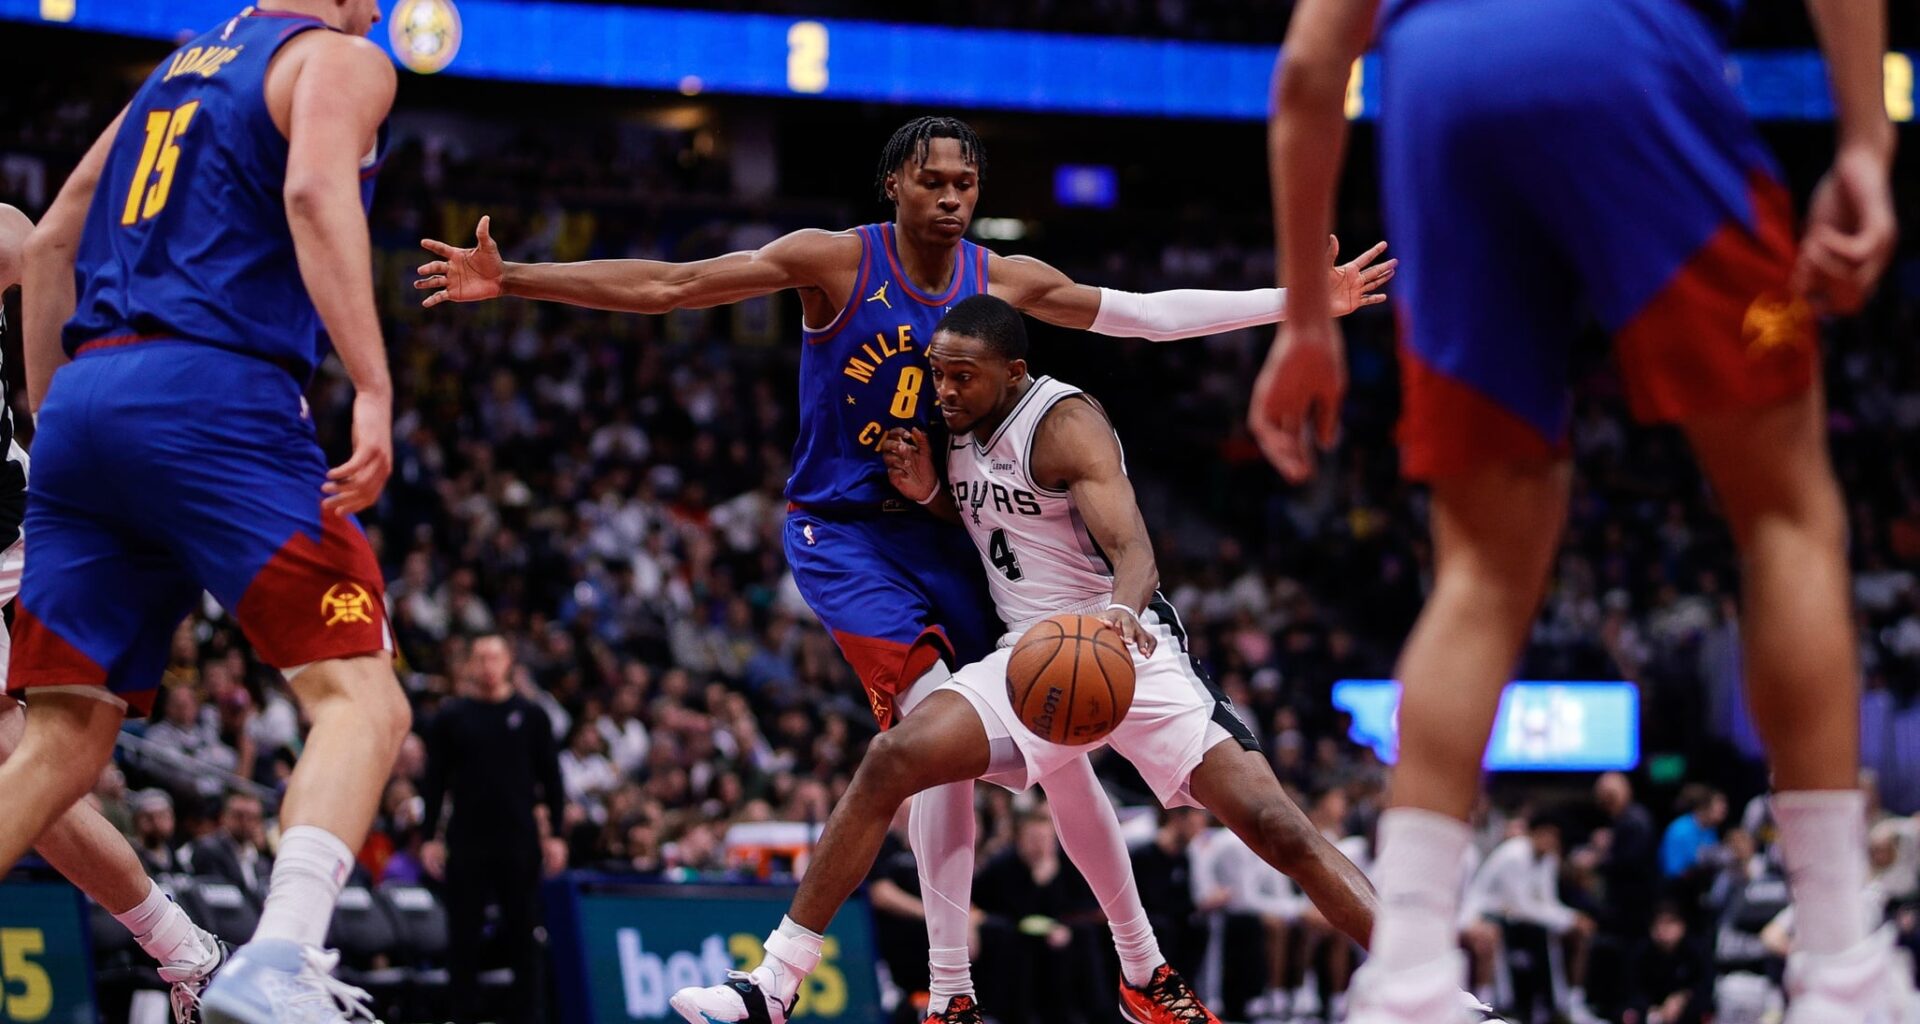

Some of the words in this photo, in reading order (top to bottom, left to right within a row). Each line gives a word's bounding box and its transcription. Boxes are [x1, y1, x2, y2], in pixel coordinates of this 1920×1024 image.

[786, 21, 830, 94] 2
[120, 100, 200, 226] 15
[843, 325, 913, 384] MILE
[889, 366, 924, 419] 8
[988, 527, 1024, 583] 4
[0, 927, 54, 1021] 5
